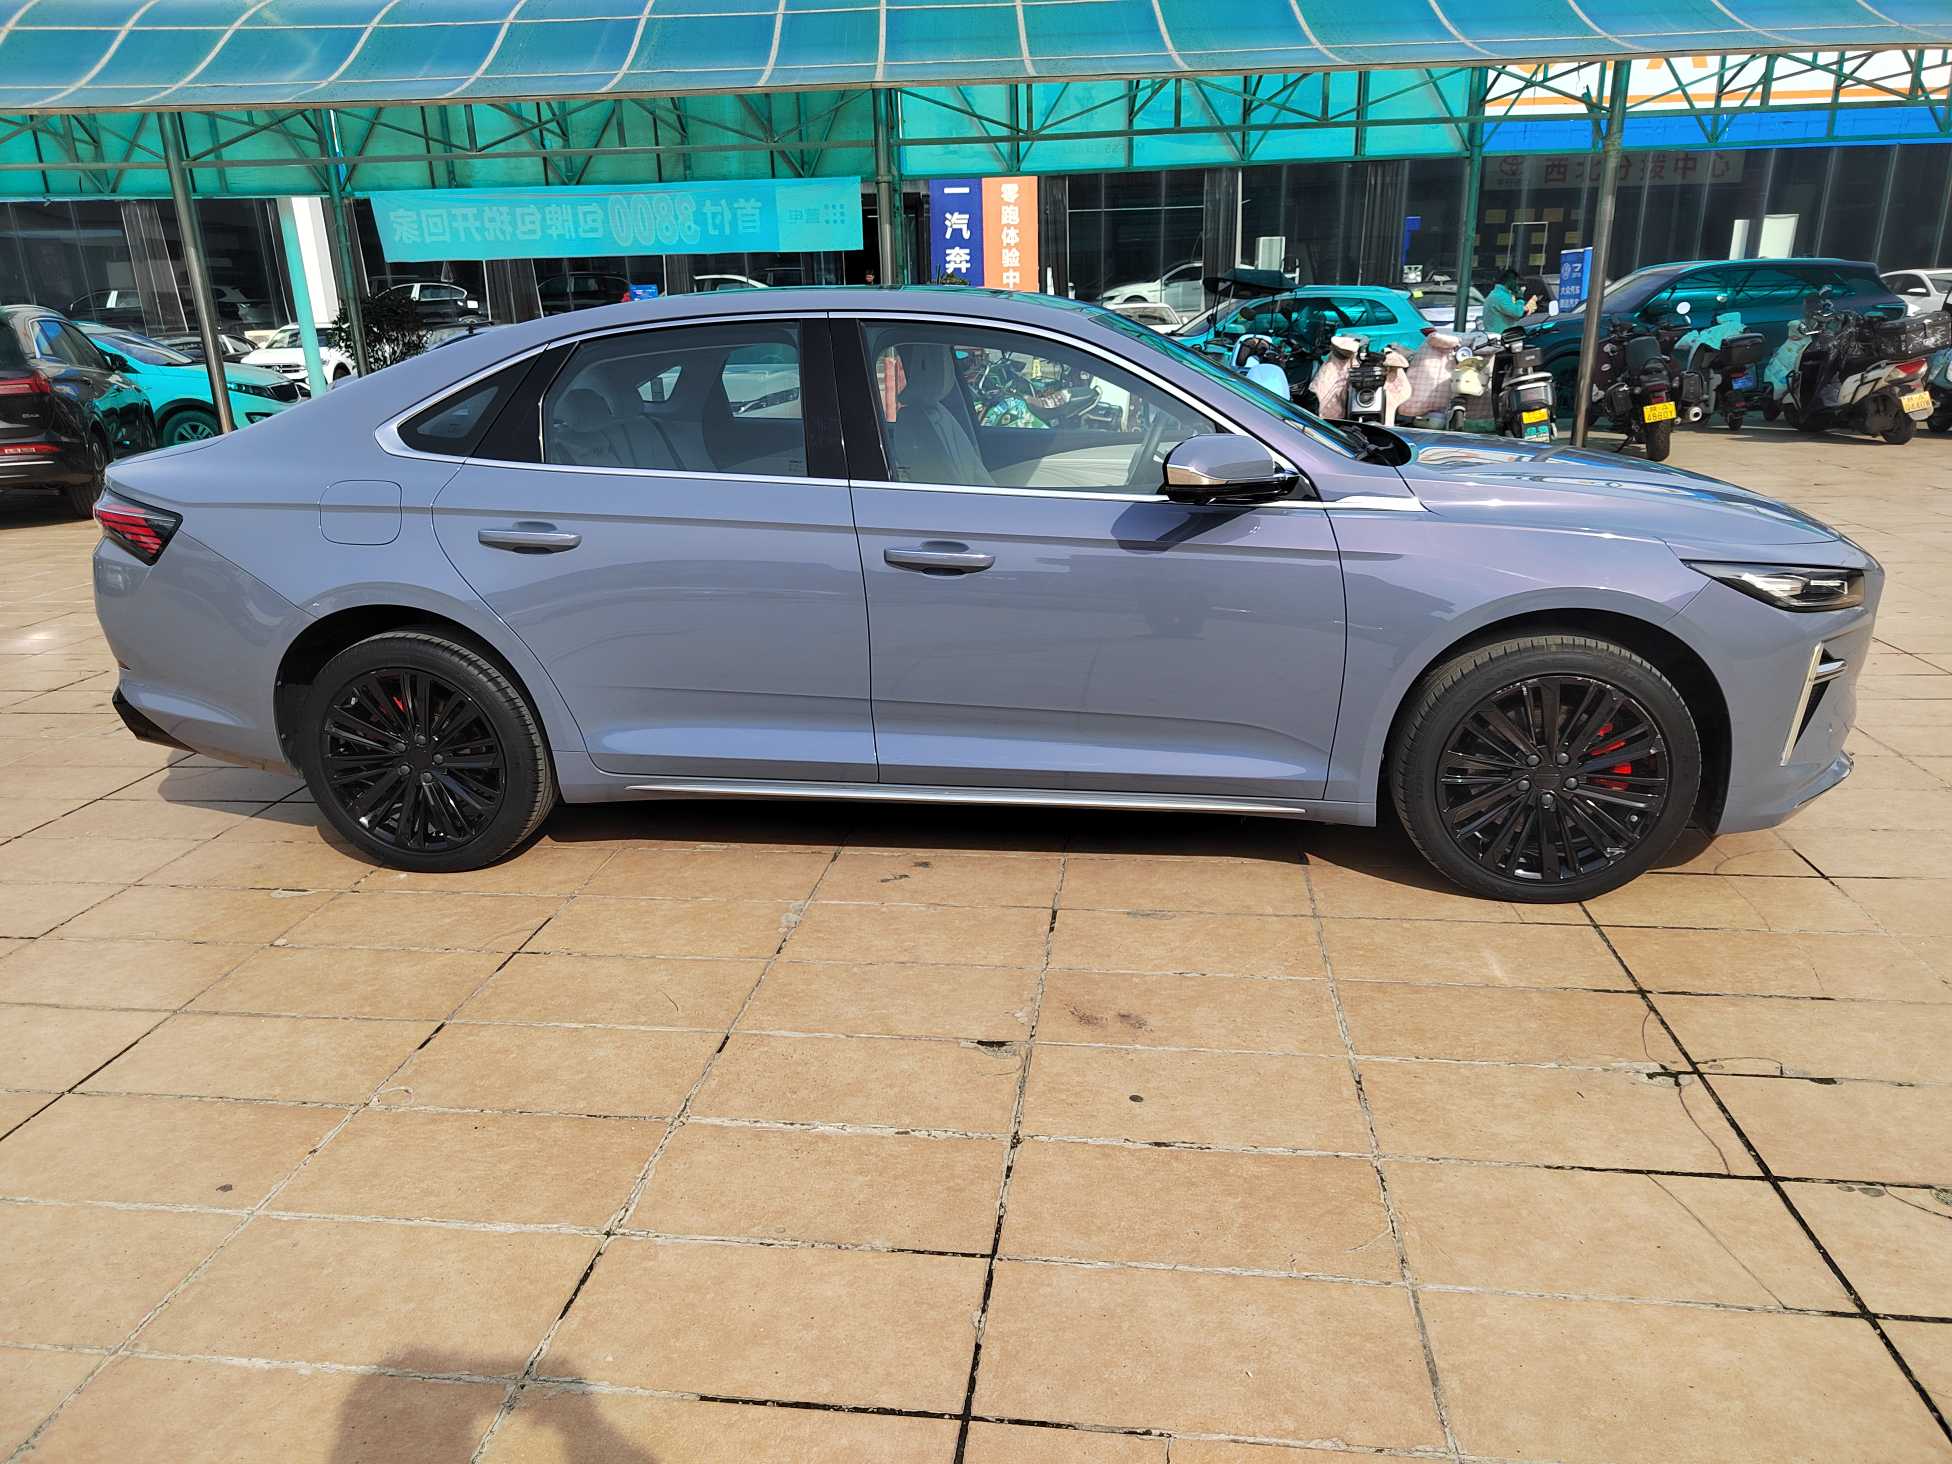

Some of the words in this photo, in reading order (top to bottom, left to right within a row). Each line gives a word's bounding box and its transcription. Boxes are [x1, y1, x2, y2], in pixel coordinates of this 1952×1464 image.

[1000, 183, 1021, 289] 零跑体验中
